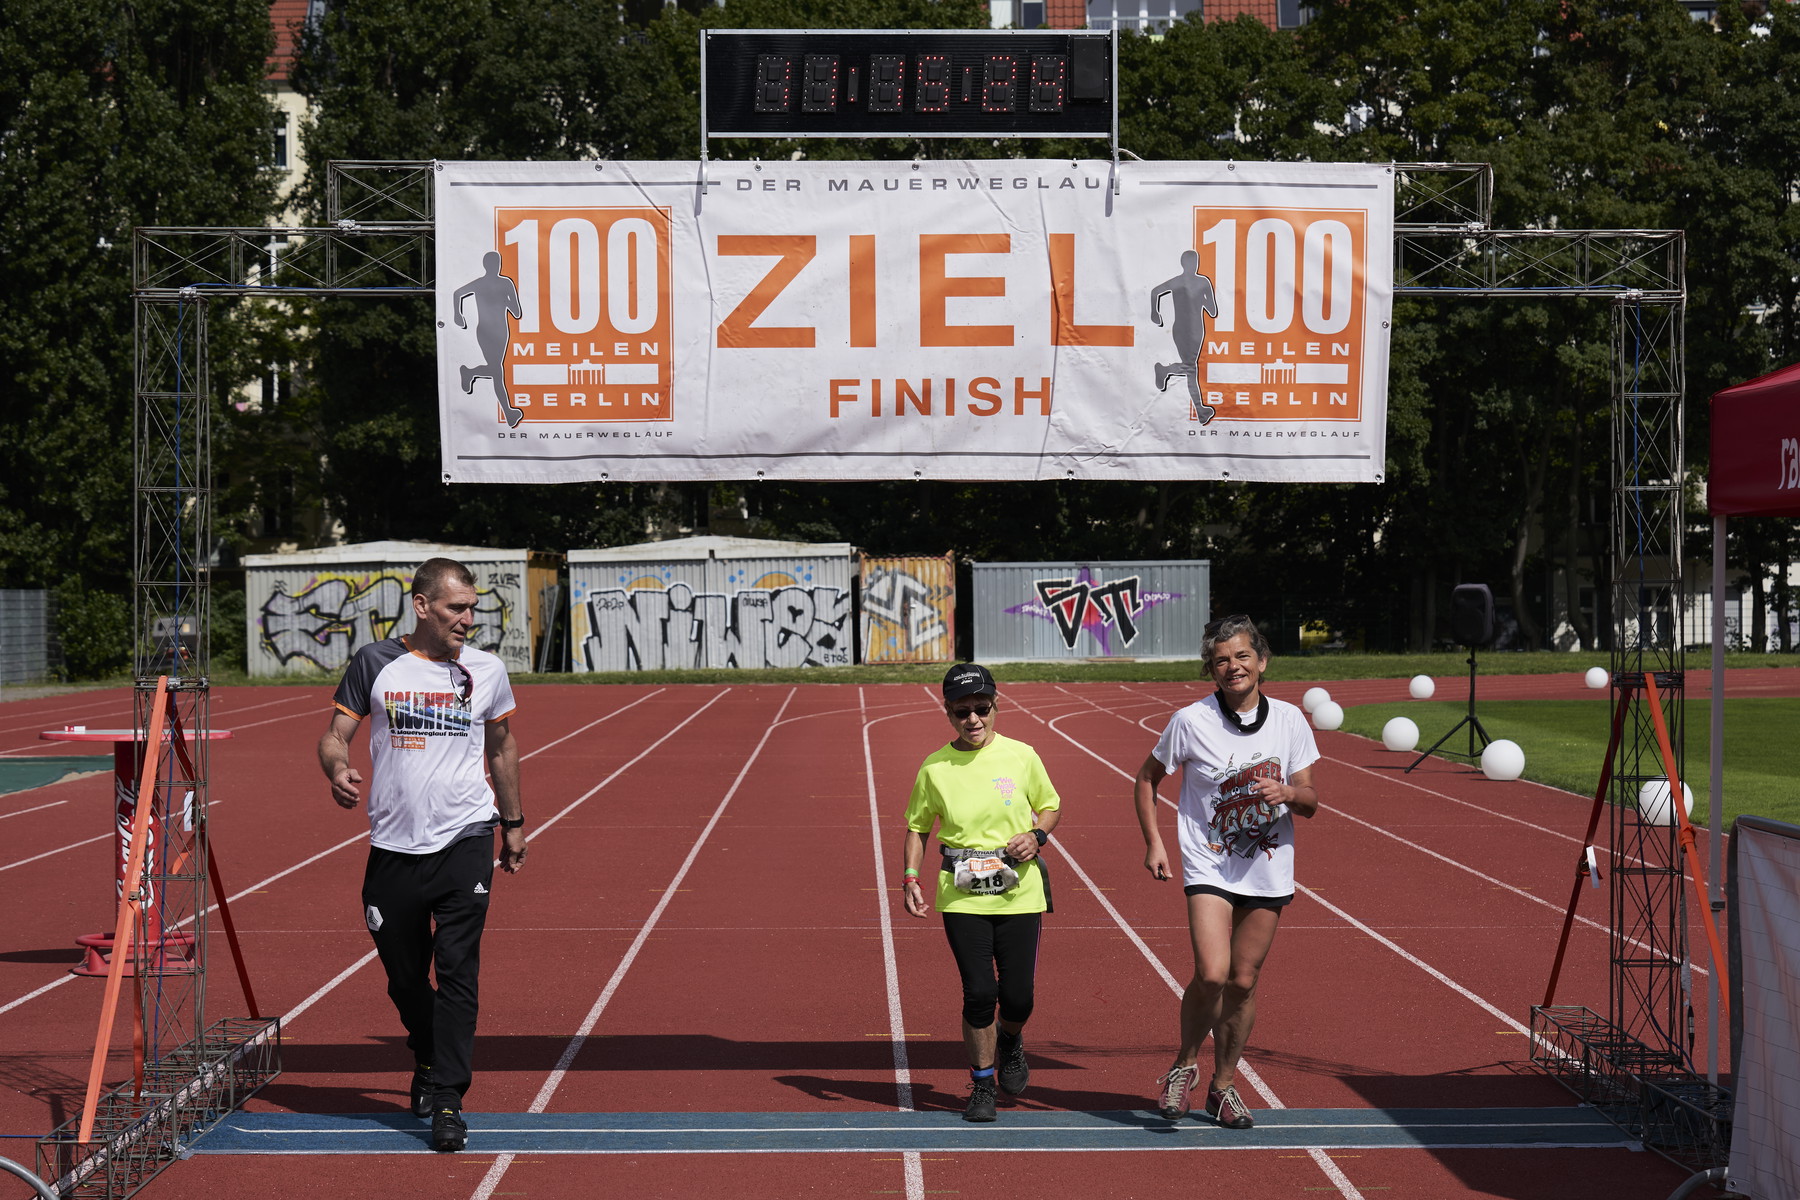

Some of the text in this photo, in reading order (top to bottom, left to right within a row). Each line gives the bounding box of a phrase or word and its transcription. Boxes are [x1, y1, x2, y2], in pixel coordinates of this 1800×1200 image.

[736, 178, 801, 192] DER
[504, 217, 659, 335] 100
[1202, 217, 1353, 335] 100
[716, 233, 1135, 348] ZIEL
[513, 342, 659, 357] MEILEN
[1207, 341, 1350, 357] MEILEN
[514, 392, 660, 407] BERLIN
[828, 376, 1051, 418] FINISH
[1206, 391, 1348, 406] BERLIN
[498, 431, 674, 440] DER MAUERWEGLAUF
[1188, 430, 1361, 439] DER MAUERWEGLAUF
[971, 874, 1003, 889] 218
